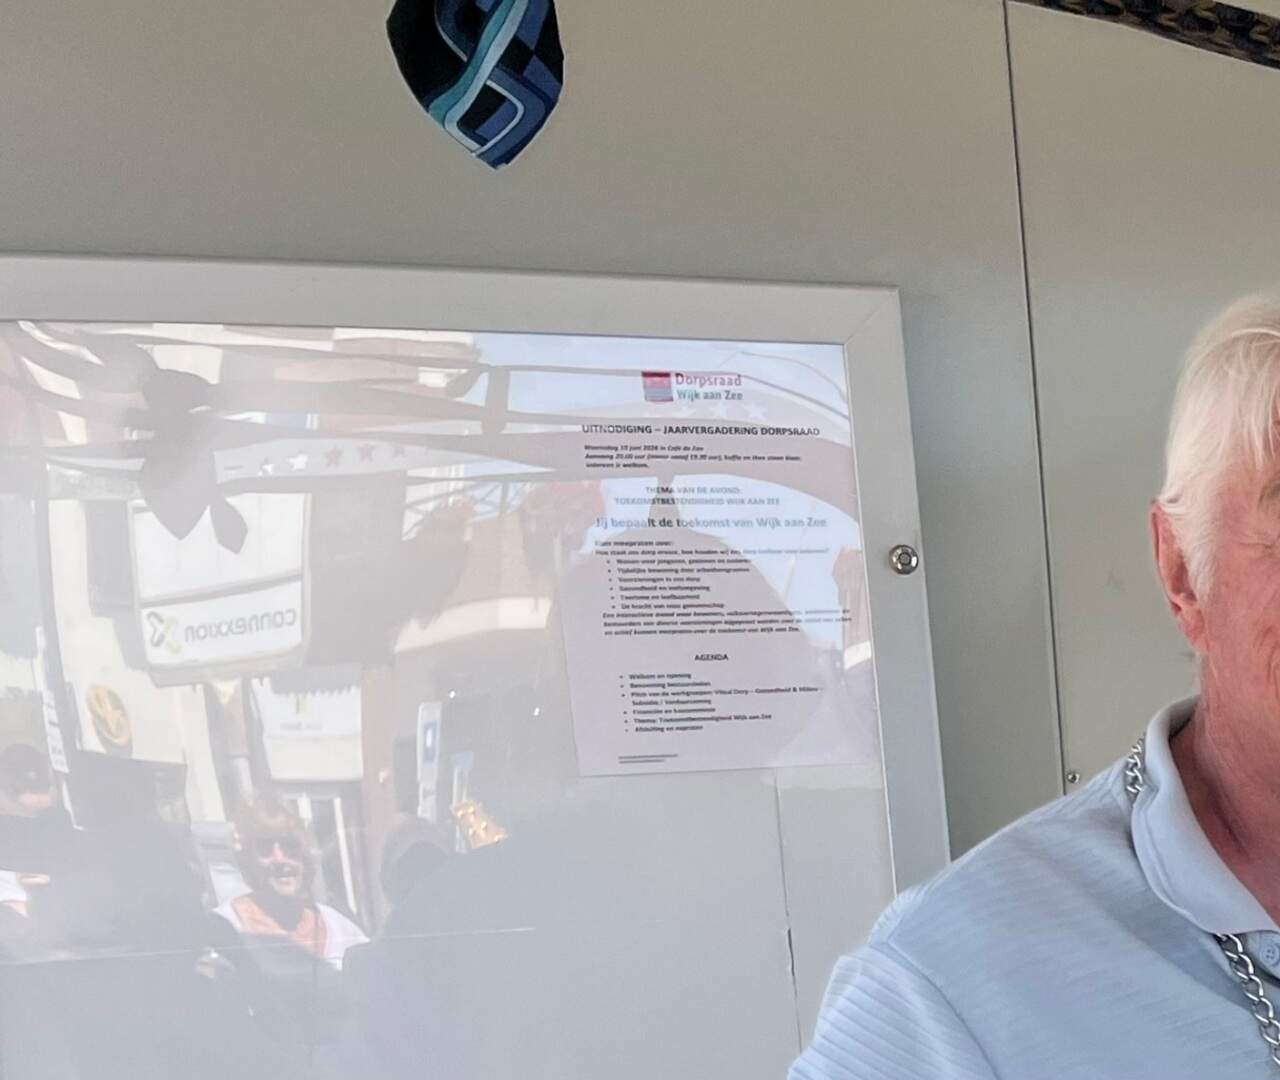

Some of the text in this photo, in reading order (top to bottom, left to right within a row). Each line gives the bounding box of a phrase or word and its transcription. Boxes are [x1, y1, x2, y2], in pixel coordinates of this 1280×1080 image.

[675, 371, 743, 388] Dorpsraad
[676, 389, 743, 402] Wijk aan Zee
[582, 424, 653, 434] UITNODIGING
[663, 425, 759, 436] JAARVERGADERING
[761, 427, 820, 436] DORPSRAAD
[659, 517, 674, 527] de
[676, 517, 730, 528] toekomst
[756, 517, 781, 530] Wijk
[694, 653, 729, 661] AGENDA
